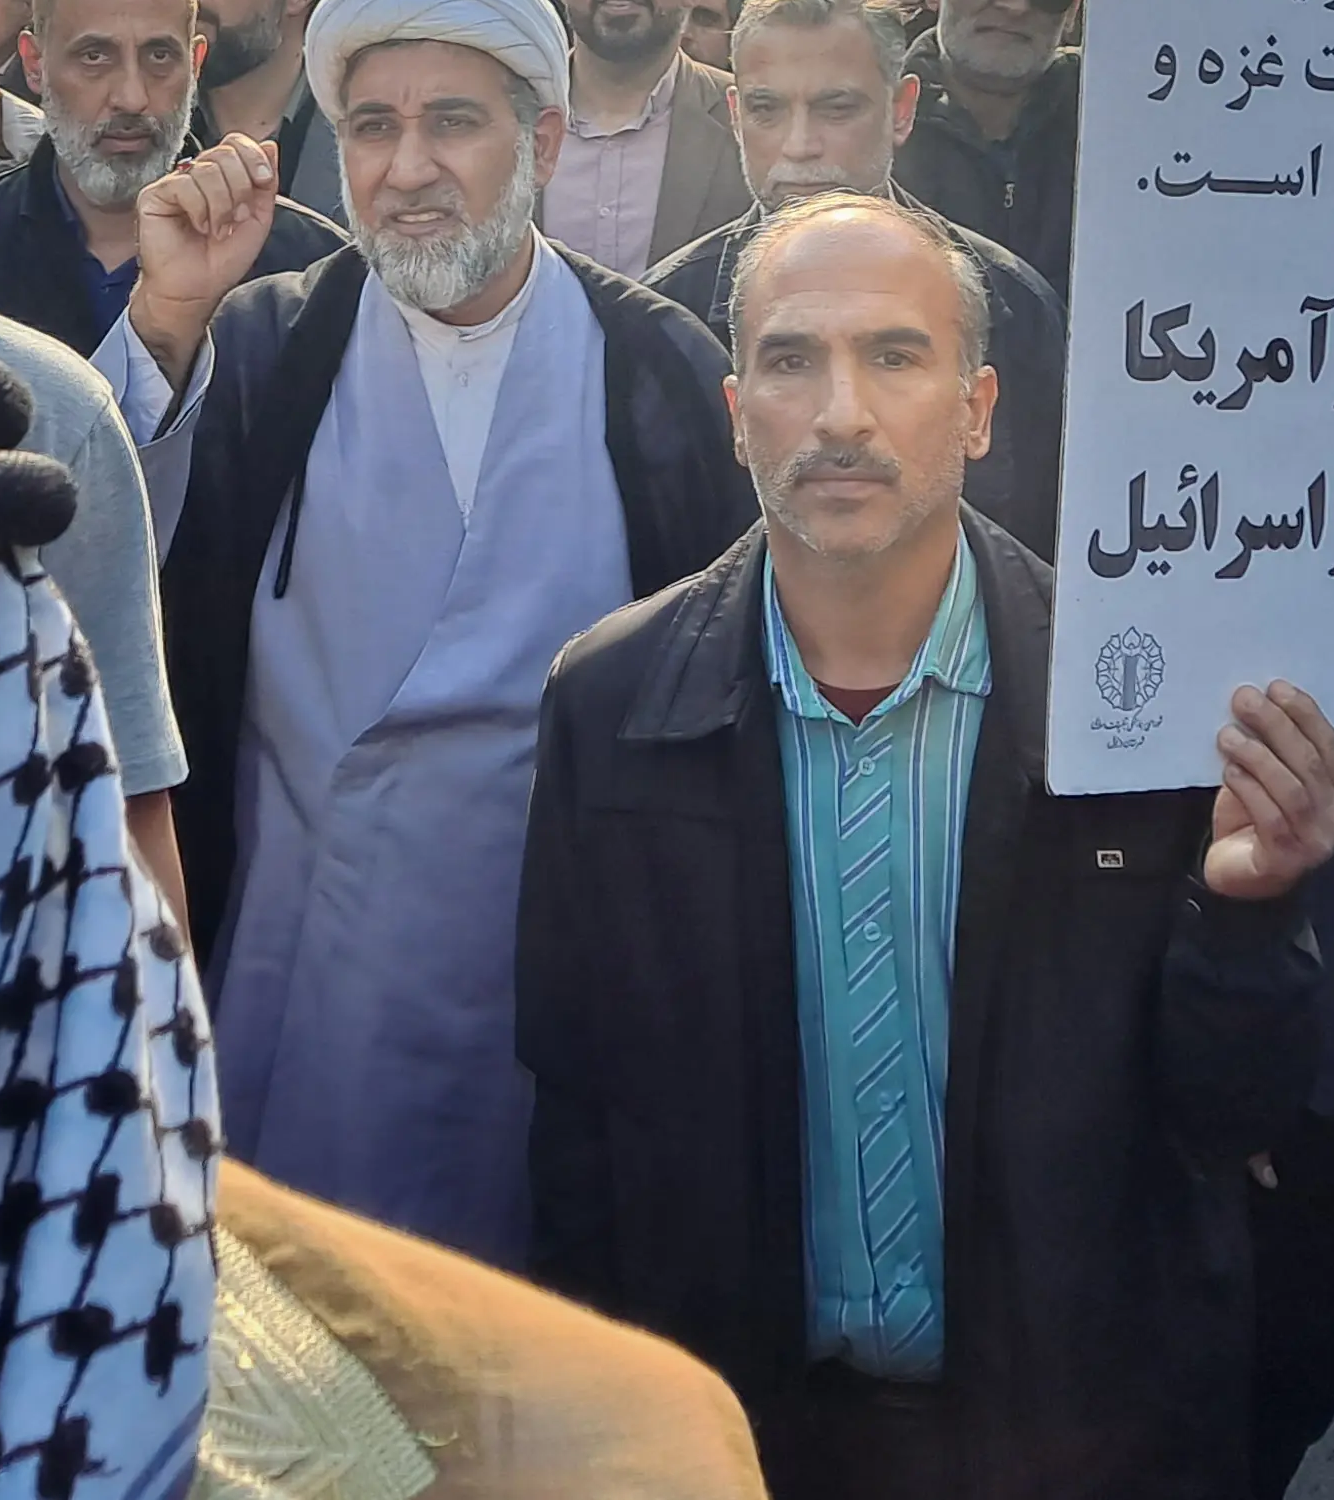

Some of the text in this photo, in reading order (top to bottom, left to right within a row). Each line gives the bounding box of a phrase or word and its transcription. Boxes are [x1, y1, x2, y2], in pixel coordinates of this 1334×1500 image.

[1148, 44, 1178, 101] و
[1198, 35, 1285, 111] غزه
[1137, 144, 1323, 197] است.
[1088, 464, 1326, 579] اسرائیل
